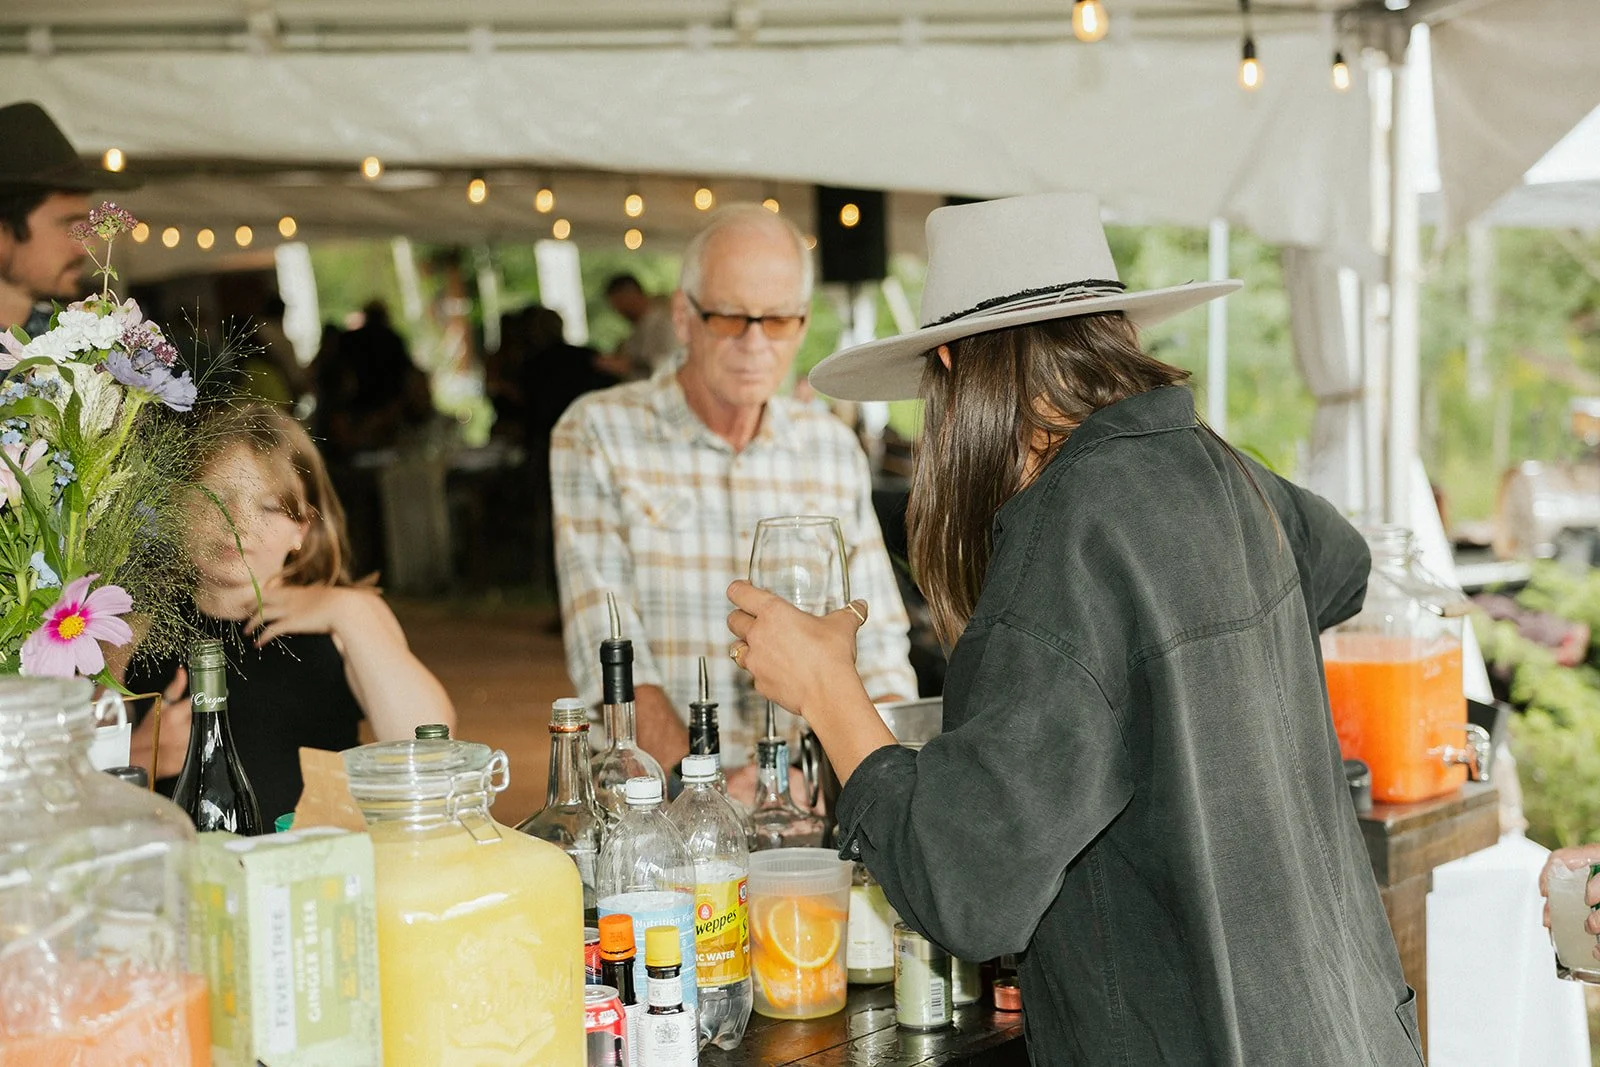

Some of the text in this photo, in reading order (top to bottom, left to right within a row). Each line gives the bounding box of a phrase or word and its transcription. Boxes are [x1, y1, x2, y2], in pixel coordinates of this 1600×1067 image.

[696, 909, 737, 935] weppes
[303, 900, 321, 1022] GINGER BEER
[706, 950, 735, 961] WATER
